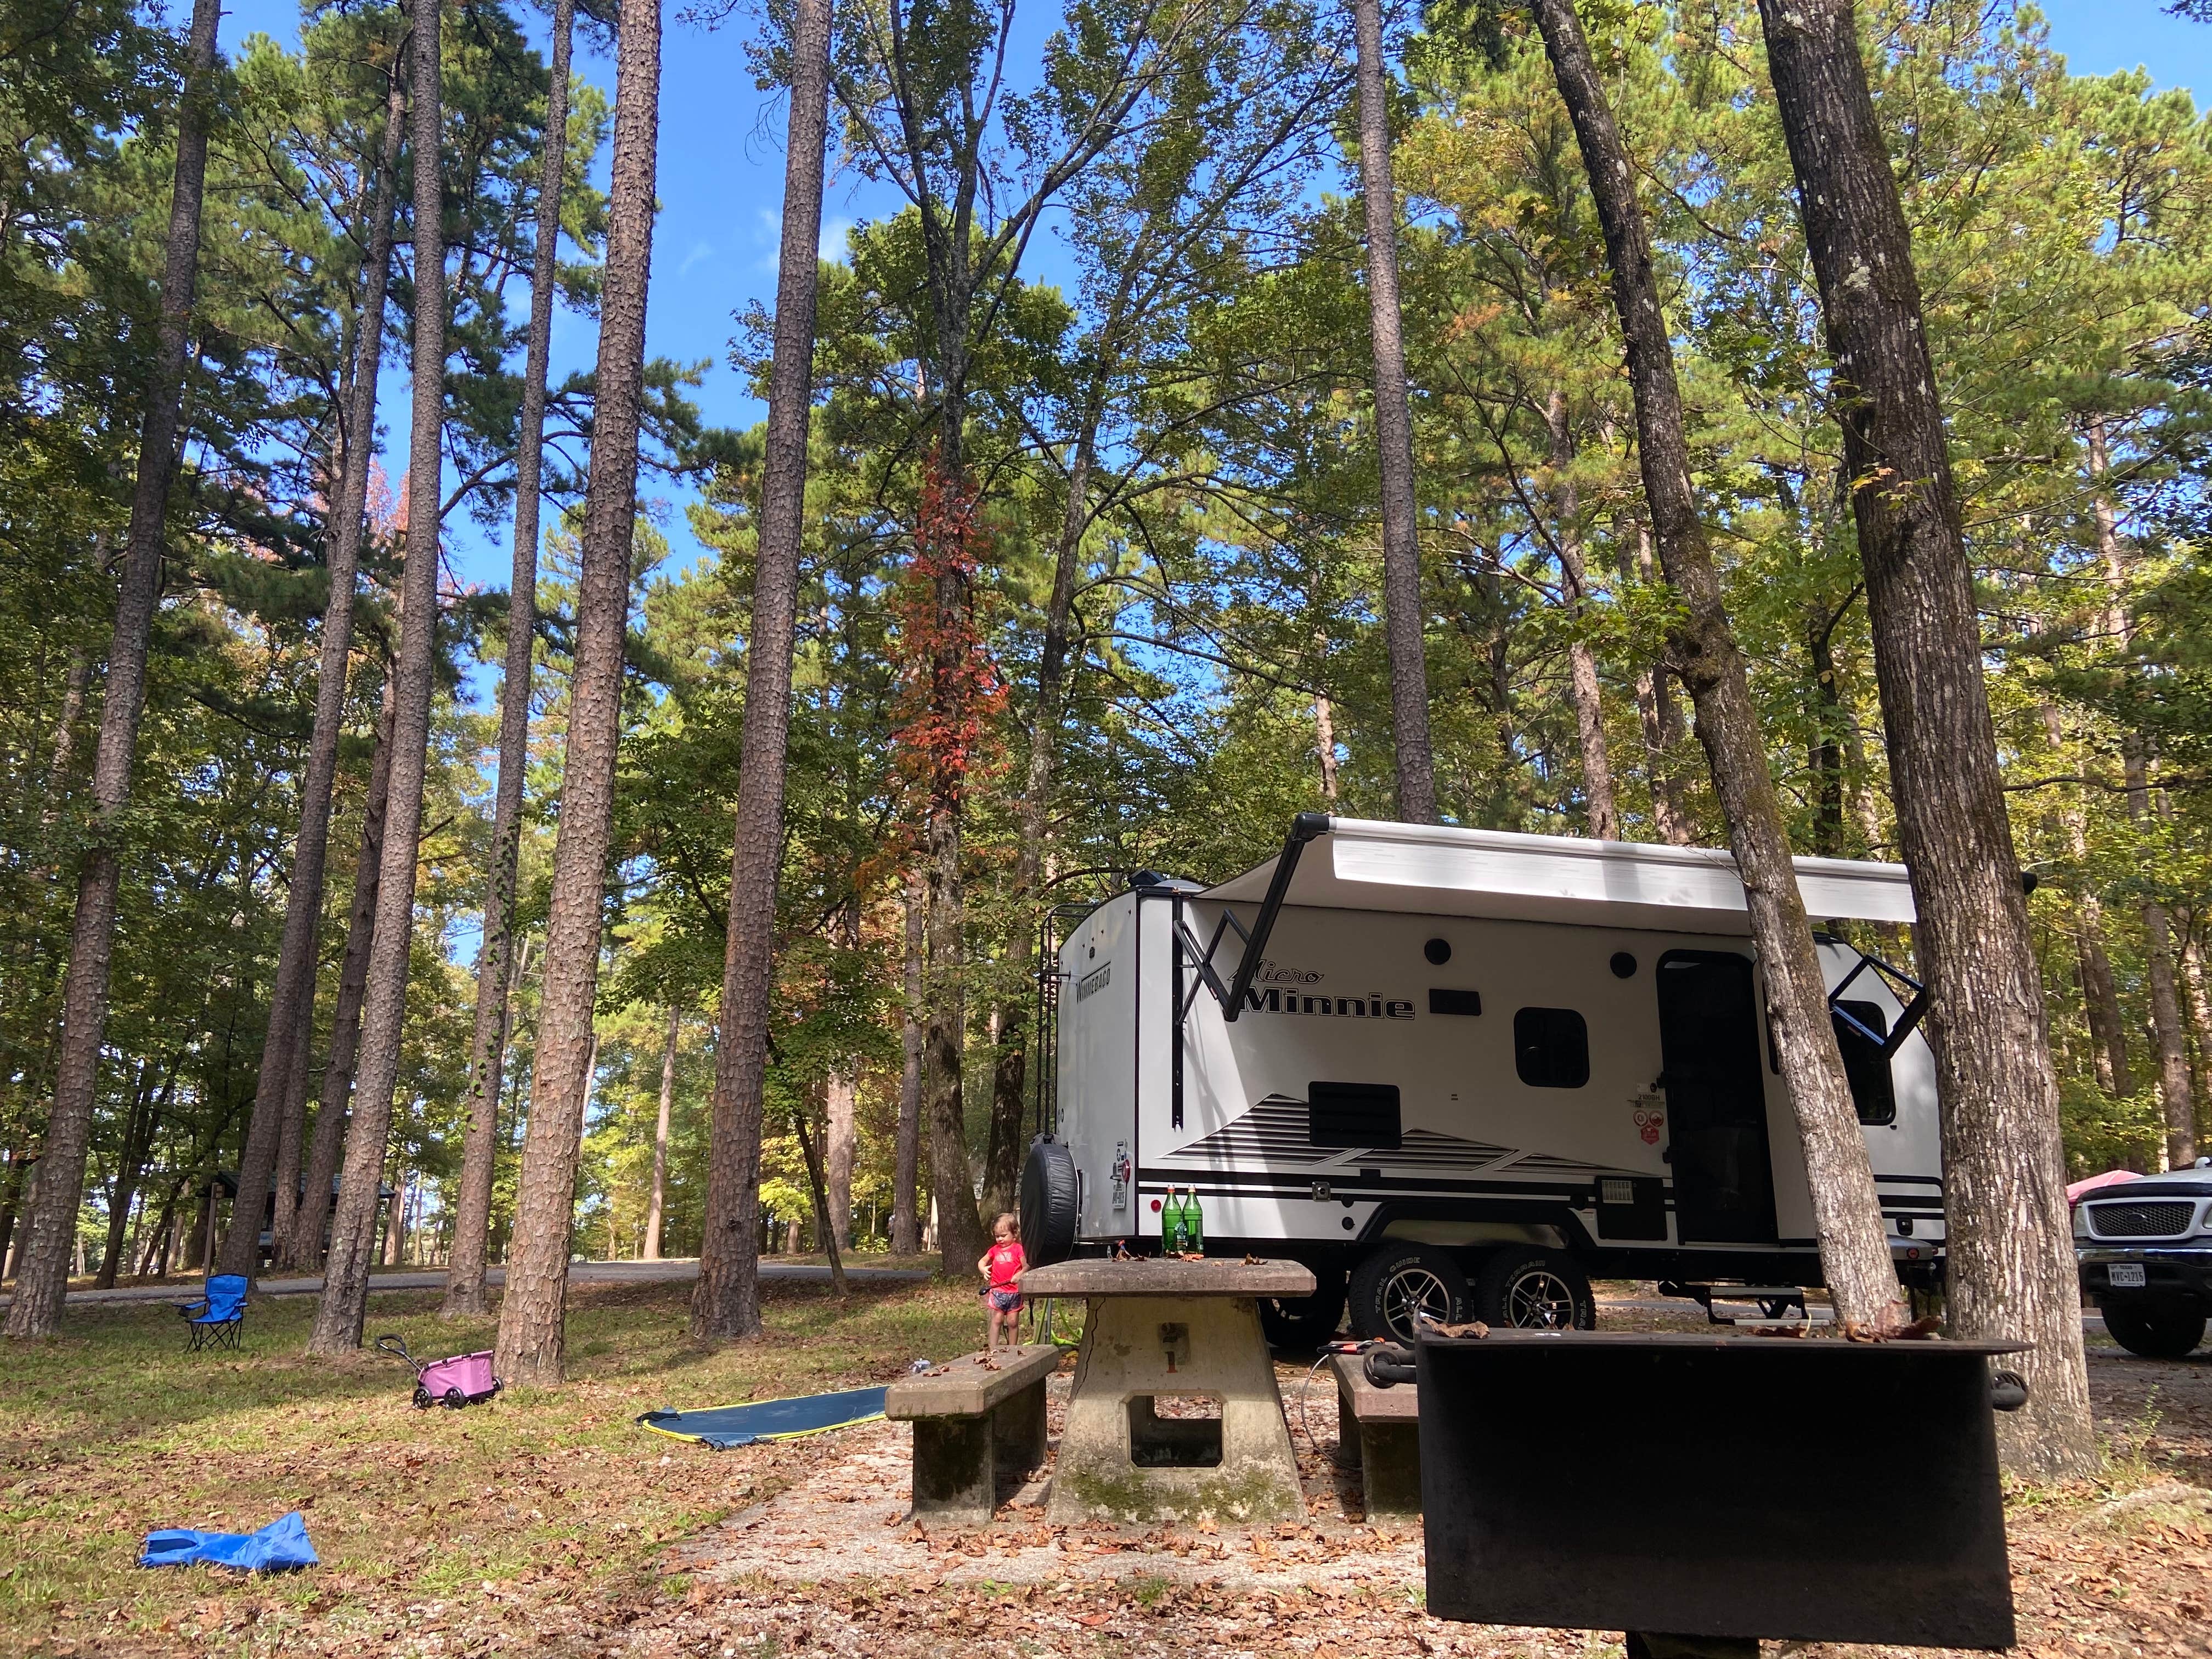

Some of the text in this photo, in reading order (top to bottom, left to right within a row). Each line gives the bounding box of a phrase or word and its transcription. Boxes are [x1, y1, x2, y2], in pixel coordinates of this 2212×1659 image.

[1076, 968, 1110, 1005] WINNEBAGO
[1239, 986, 1415, 1020] Minnie
[1375, 1257, 1421, 1314] TRAIL GUIDE
[1505, 1260, 1546, 1288] TERRAIN
[1455, 1296, 1463, 1322] ALL
